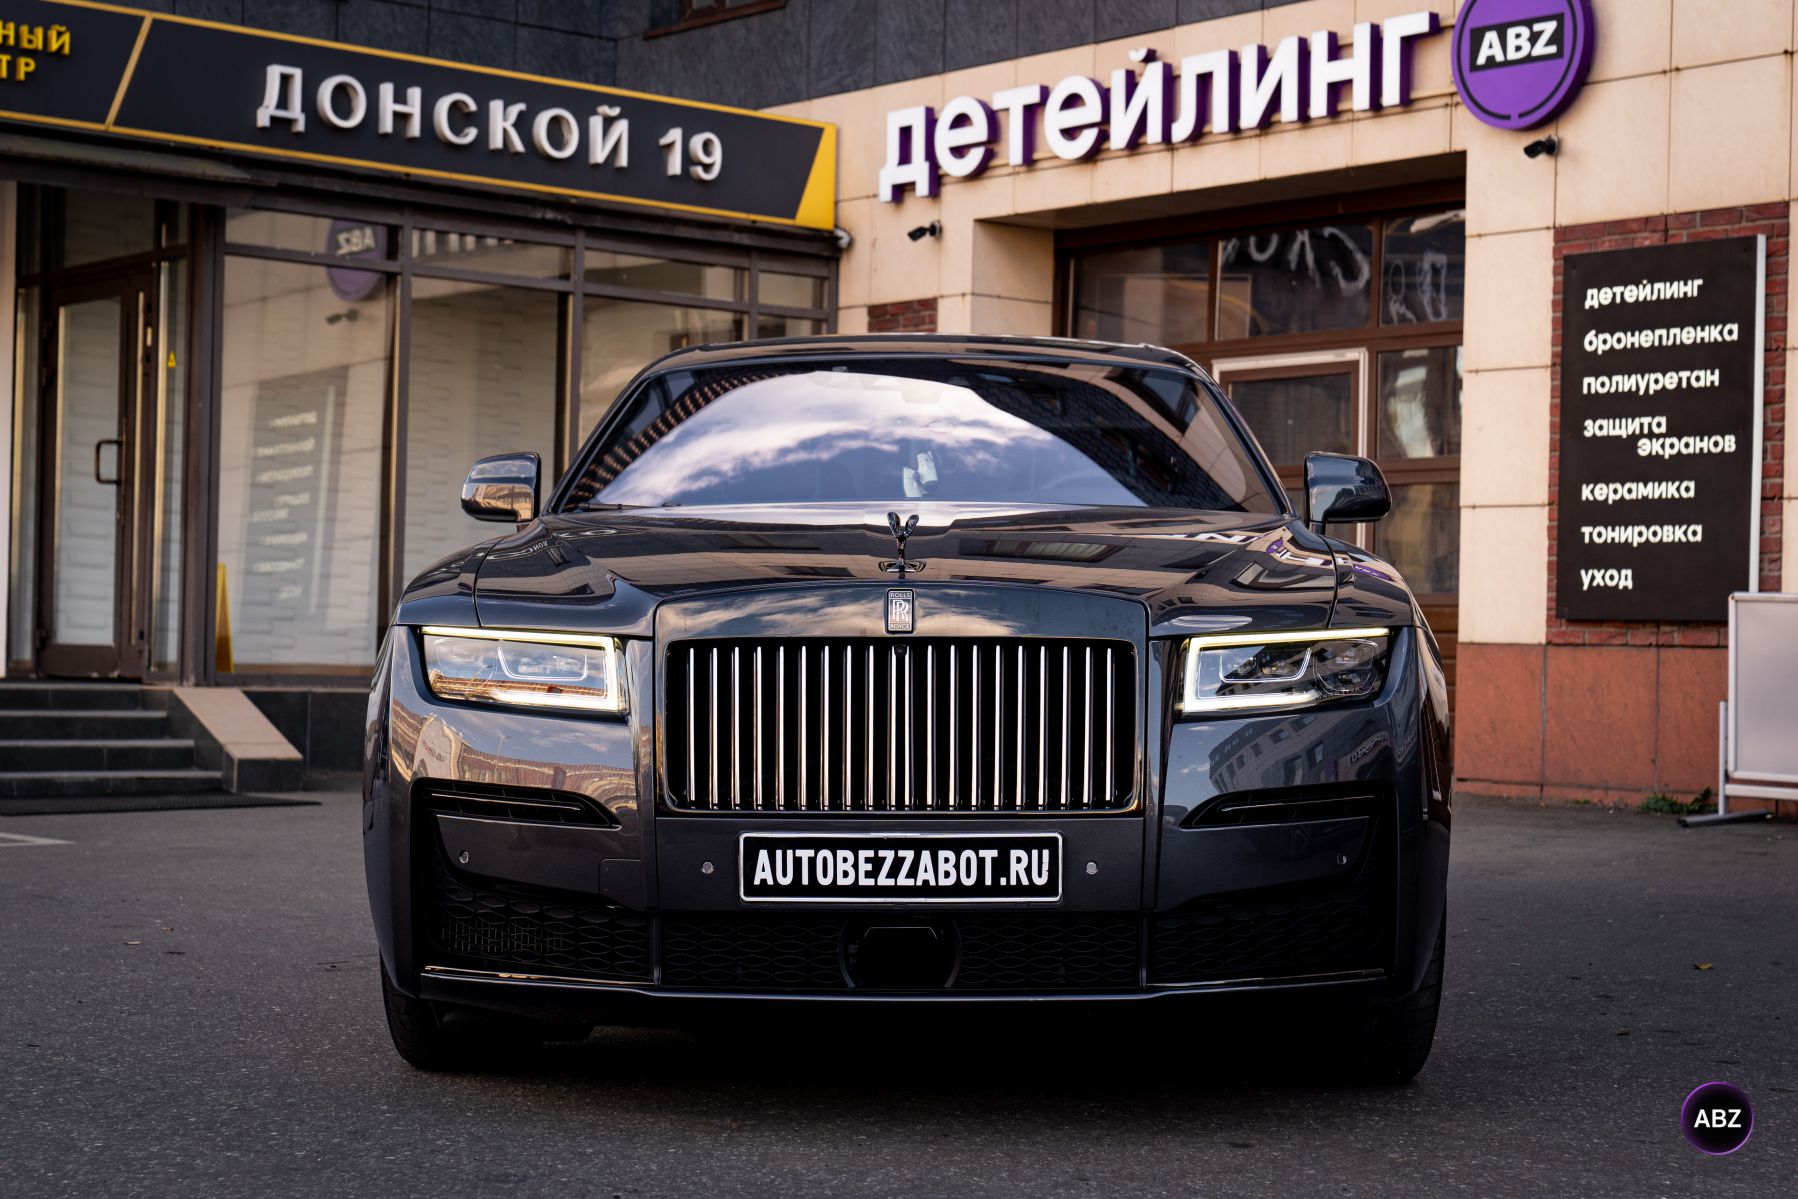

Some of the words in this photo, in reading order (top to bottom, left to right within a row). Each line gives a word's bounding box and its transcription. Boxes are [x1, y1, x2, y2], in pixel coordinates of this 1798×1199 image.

[1475, 20, 1558, 66] ABZ
[878, 11, 1439, 203] детейлинг
[256, 63, 629, 169] ДОНСКОЙ
[658, 126, 723, 182] 19
[1584, 278, 1704, 310] детейлинг
[1583, 322, 1739, 355] бронепленка
[1582, 368, 1720, 395] полиуретан
[1583, 416, 1667, 438] защита
[1636, 434, 1737, 459] экранов
[1581, 480, 1696, 504] керамика
[1580, 524, 1703, 547] тонировка
[1580, 568, 1633, 591] уход
[753, 849, 1050, 886] AUTOBEZZABOT.RU
